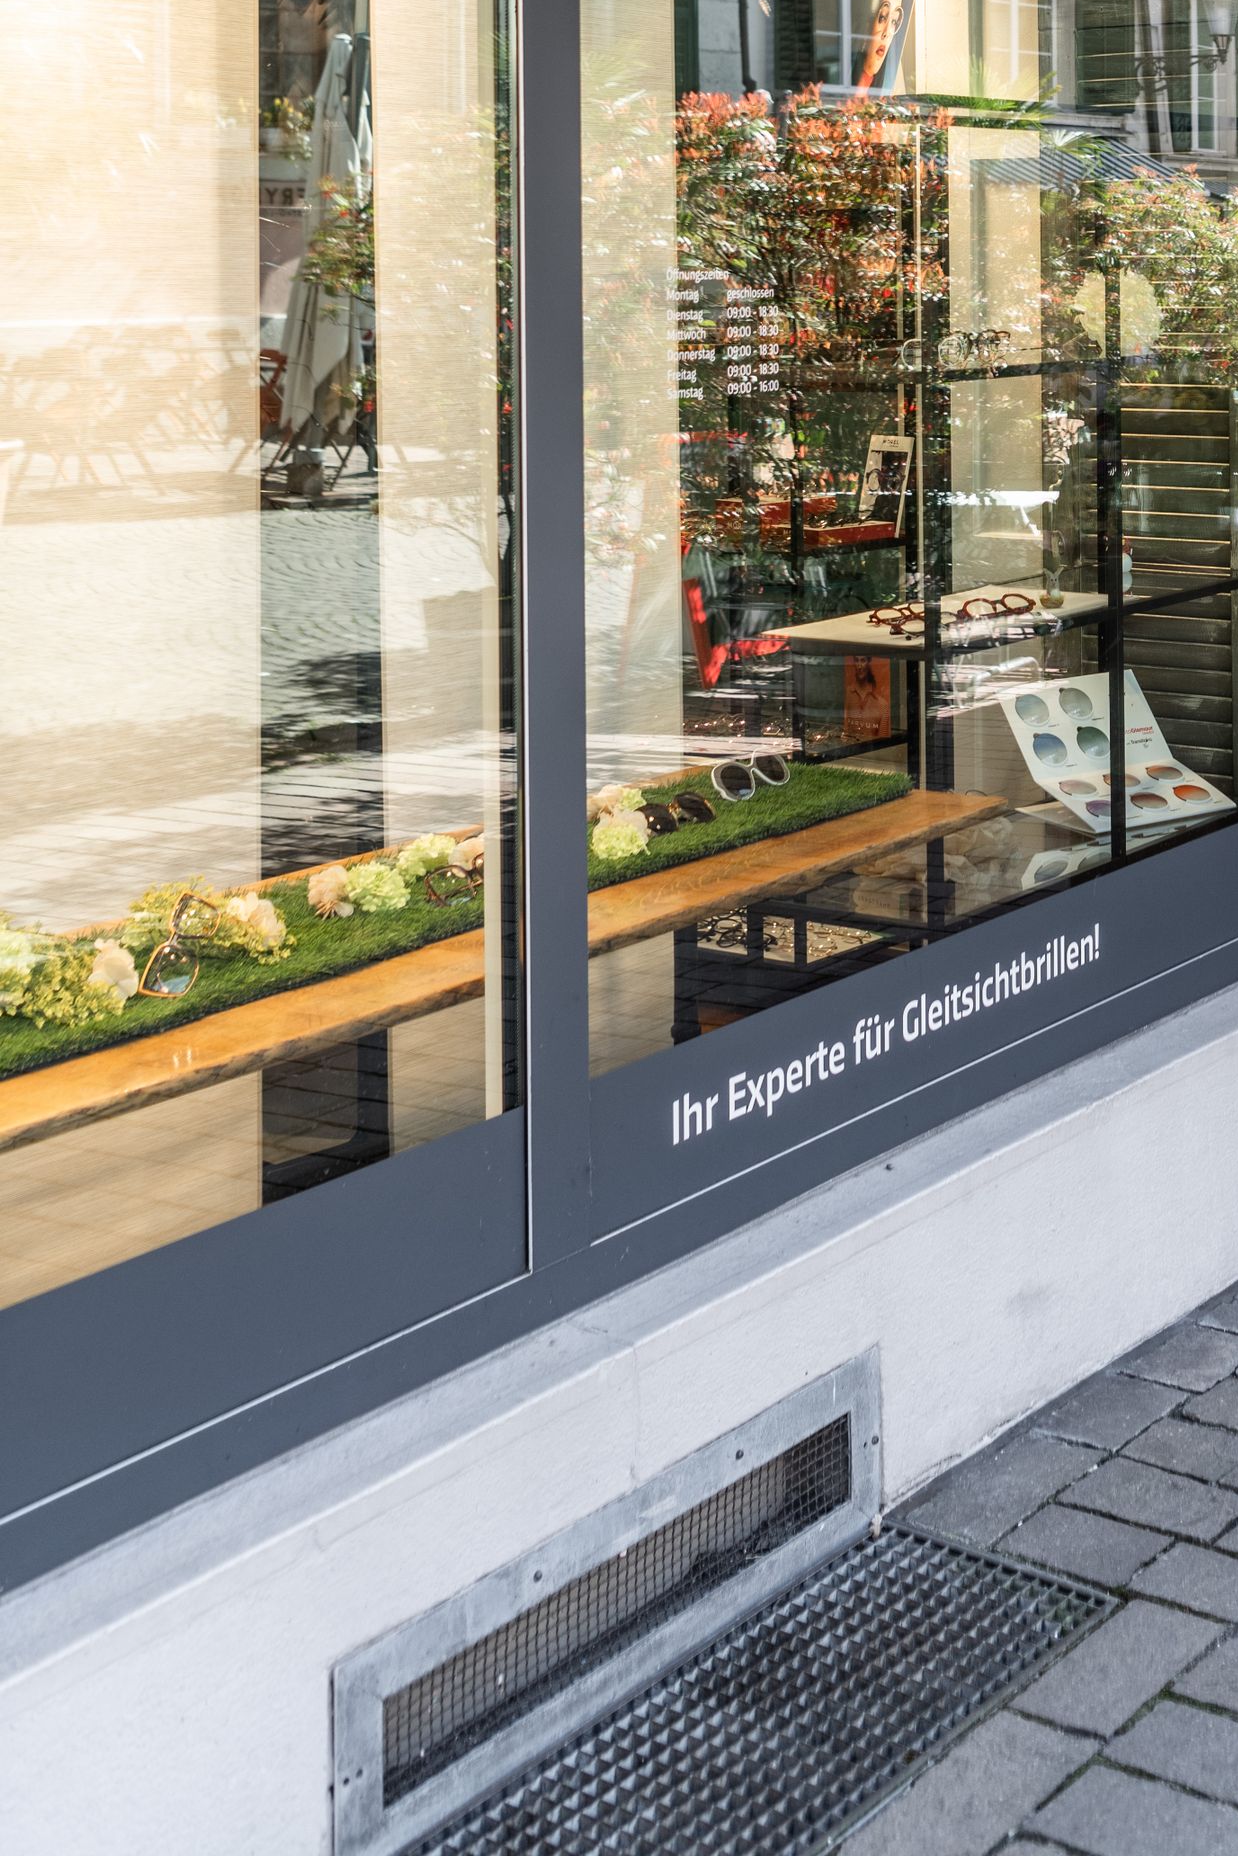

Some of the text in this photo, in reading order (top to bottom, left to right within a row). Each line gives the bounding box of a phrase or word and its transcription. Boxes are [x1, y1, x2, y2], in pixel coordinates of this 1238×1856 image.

[666, 267, 729, 284] Öffnungszeiten
[666, 287, 775, 303] Montag geschlossen
[666, 309, 704, 323] Dienstag
[727, 307, 752, 319] 09:00
[759, 305, 779, 317] 18:30
[666, 328, 706, 341] Mittwoch
[727, 326, 752, 338] 09:00
[759, 324, 779, 336] 18:30
[667, 348, 716, 362] Donnerstag
[727, 345, 752, 358] 09:00
[759, 343, 779, 355] 18:30
[667, 369, 697, 383] Freitag
[727, 365, 752, 377] 09:00
[759, 362, 779, 374] 18:30
[667, 387, 704, 401] Samstag
[727, 382, 752, 394] 09:00
[759, 380, 779, 391] 16:00
[673, 923, 1100, 1146] Ihr Experte für Gleitsichtbrillen!
